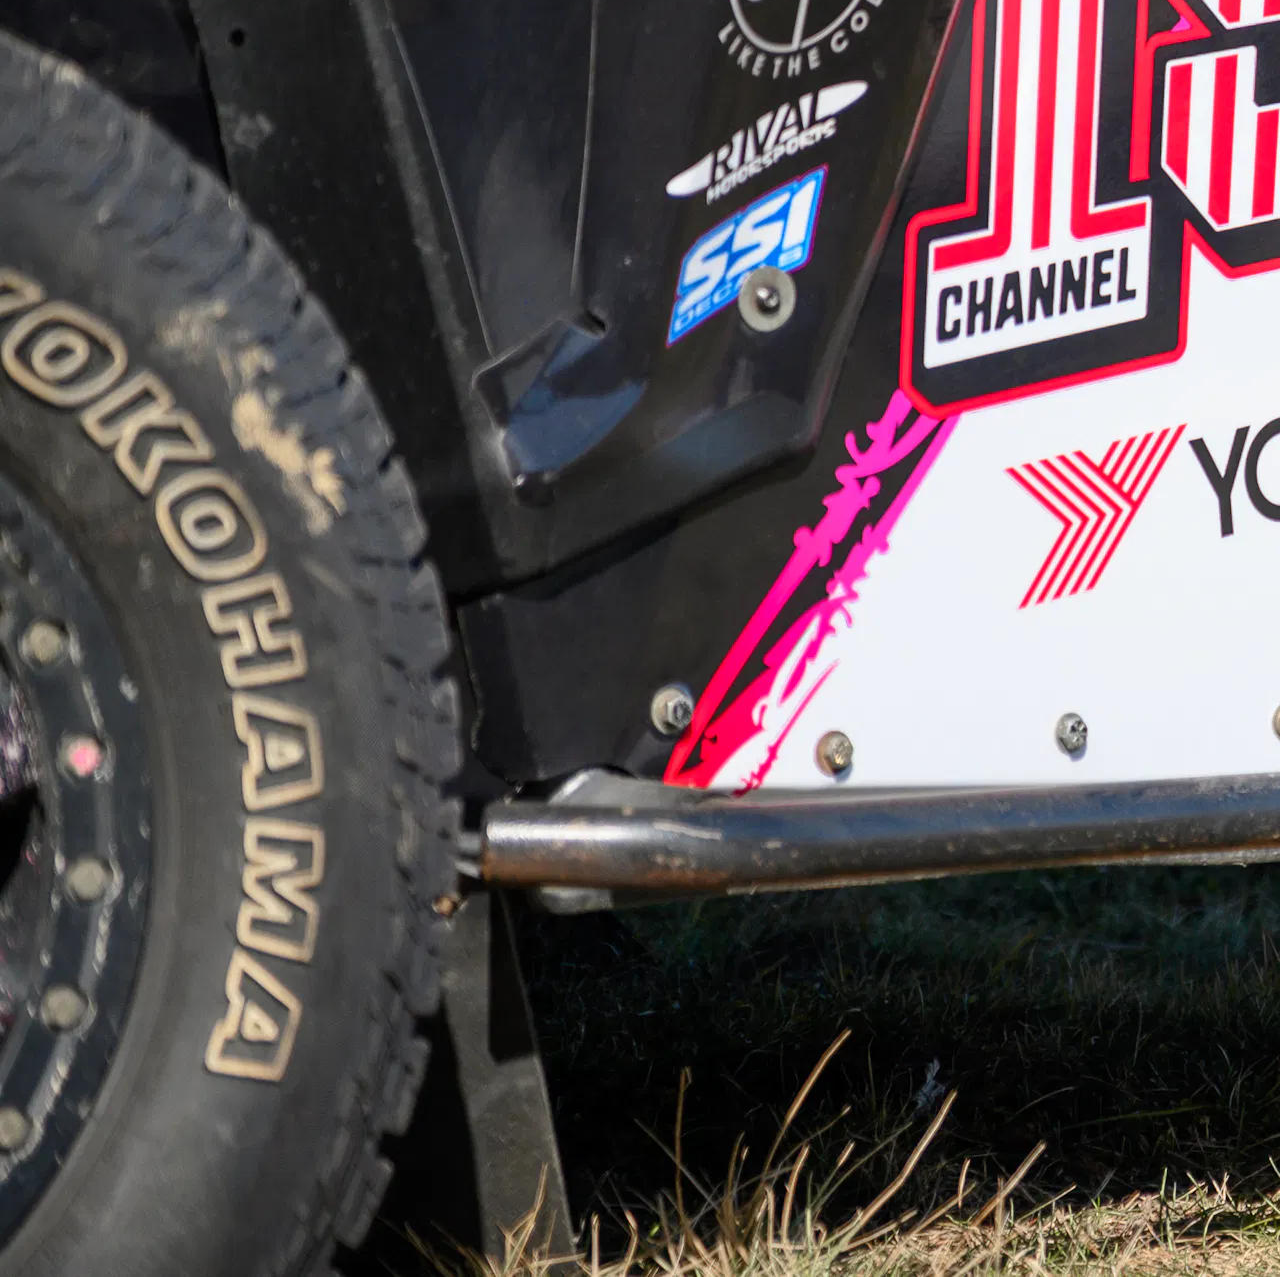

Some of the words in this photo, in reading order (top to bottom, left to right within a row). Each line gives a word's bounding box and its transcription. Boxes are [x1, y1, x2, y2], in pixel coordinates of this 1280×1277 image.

[717, 20, 767, 78] LIKE
[772, 46, 822, 80] THE
[706, 117, 838, 206] MOTORSPORTS
[676, 180, 817, 314] SSI
[936, 247, 1137, 343] CHANNEL
